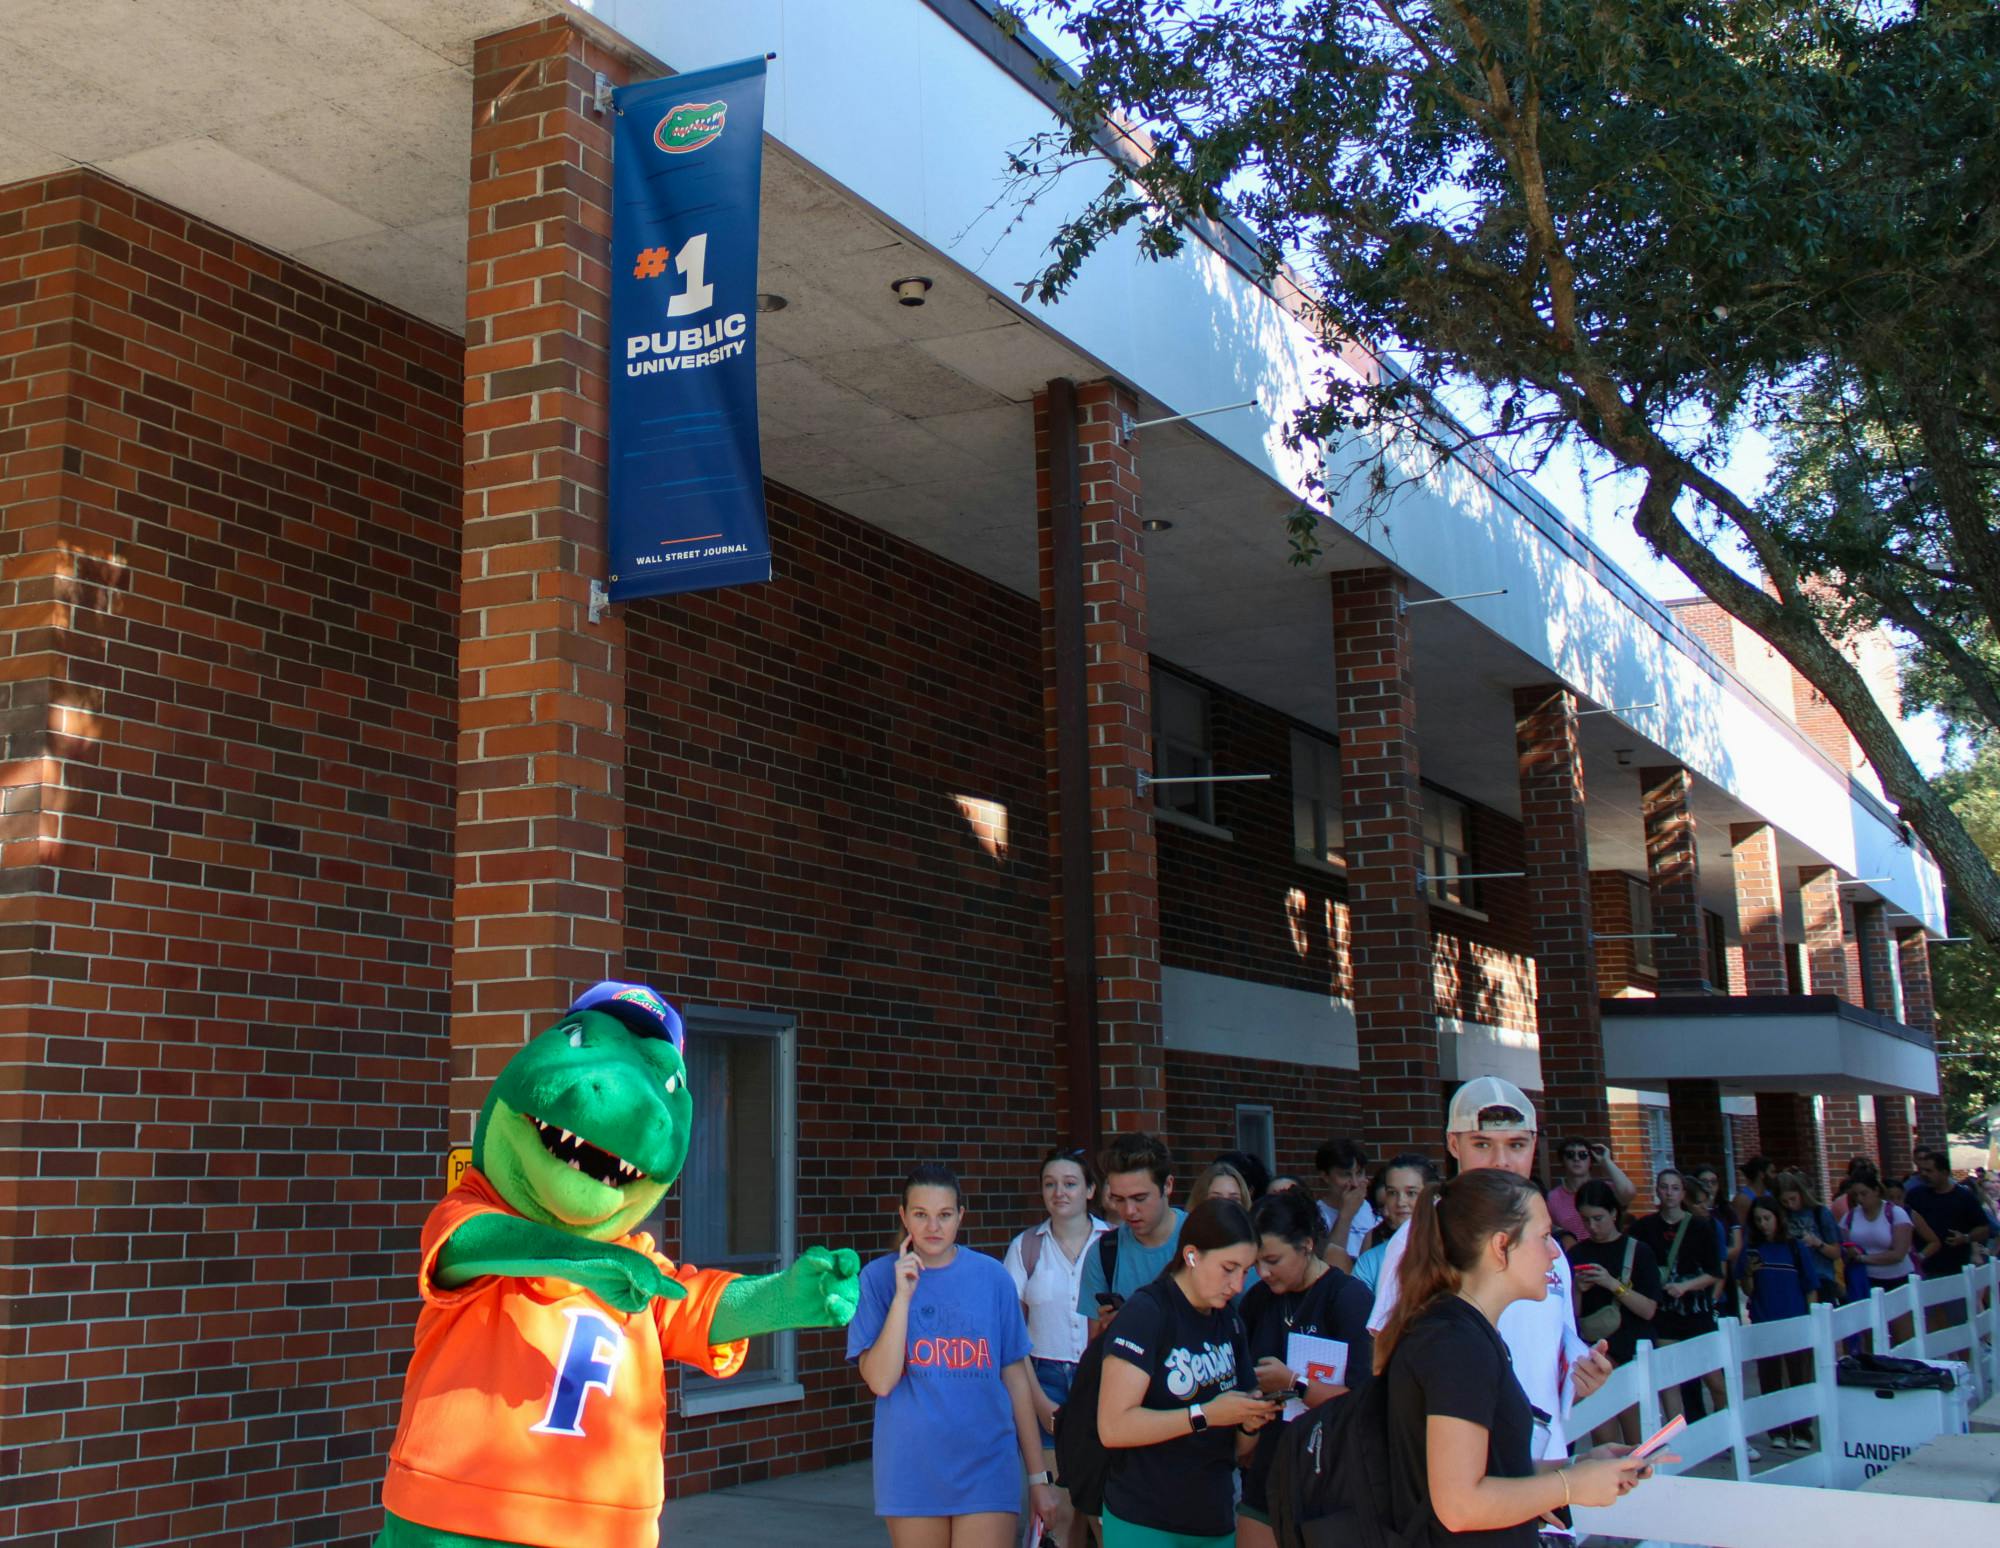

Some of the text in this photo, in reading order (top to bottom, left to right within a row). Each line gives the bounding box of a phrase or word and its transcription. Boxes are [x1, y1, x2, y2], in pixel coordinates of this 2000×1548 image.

[633, 232, 714, 318] #1
[627, 313, 746, 359] PUBLIC
[627, 340, 746, 377] UNIVERSITY
[636, 543, 748, 566] WALL STREET JOURNAL
[529, 1308, 624, 1437] F
